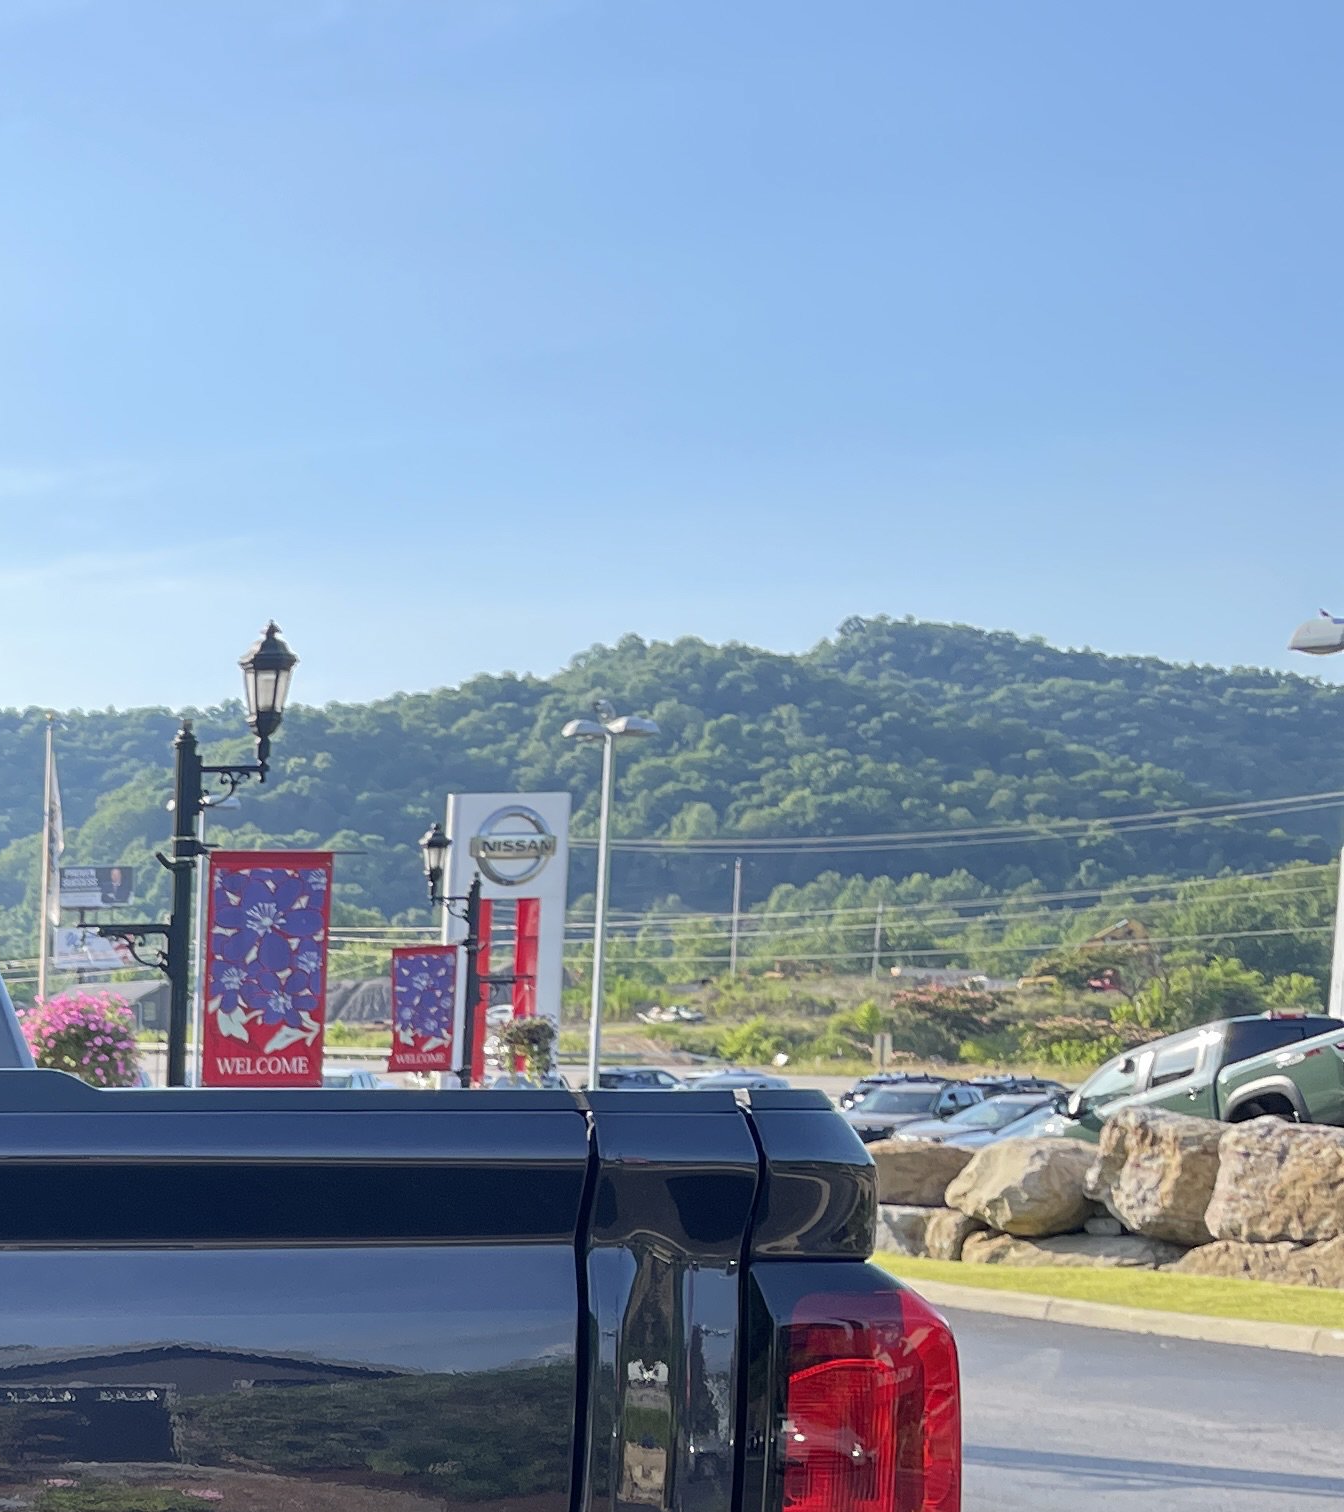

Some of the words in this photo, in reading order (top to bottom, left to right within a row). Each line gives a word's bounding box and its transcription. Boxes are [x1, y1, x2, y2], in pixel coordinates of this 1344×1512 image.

[481, 839, 552, 853] NISSAN
[217, 1056, 309, 1075] WELCOME
[395, 1052, 446, 1065] WELCOME
